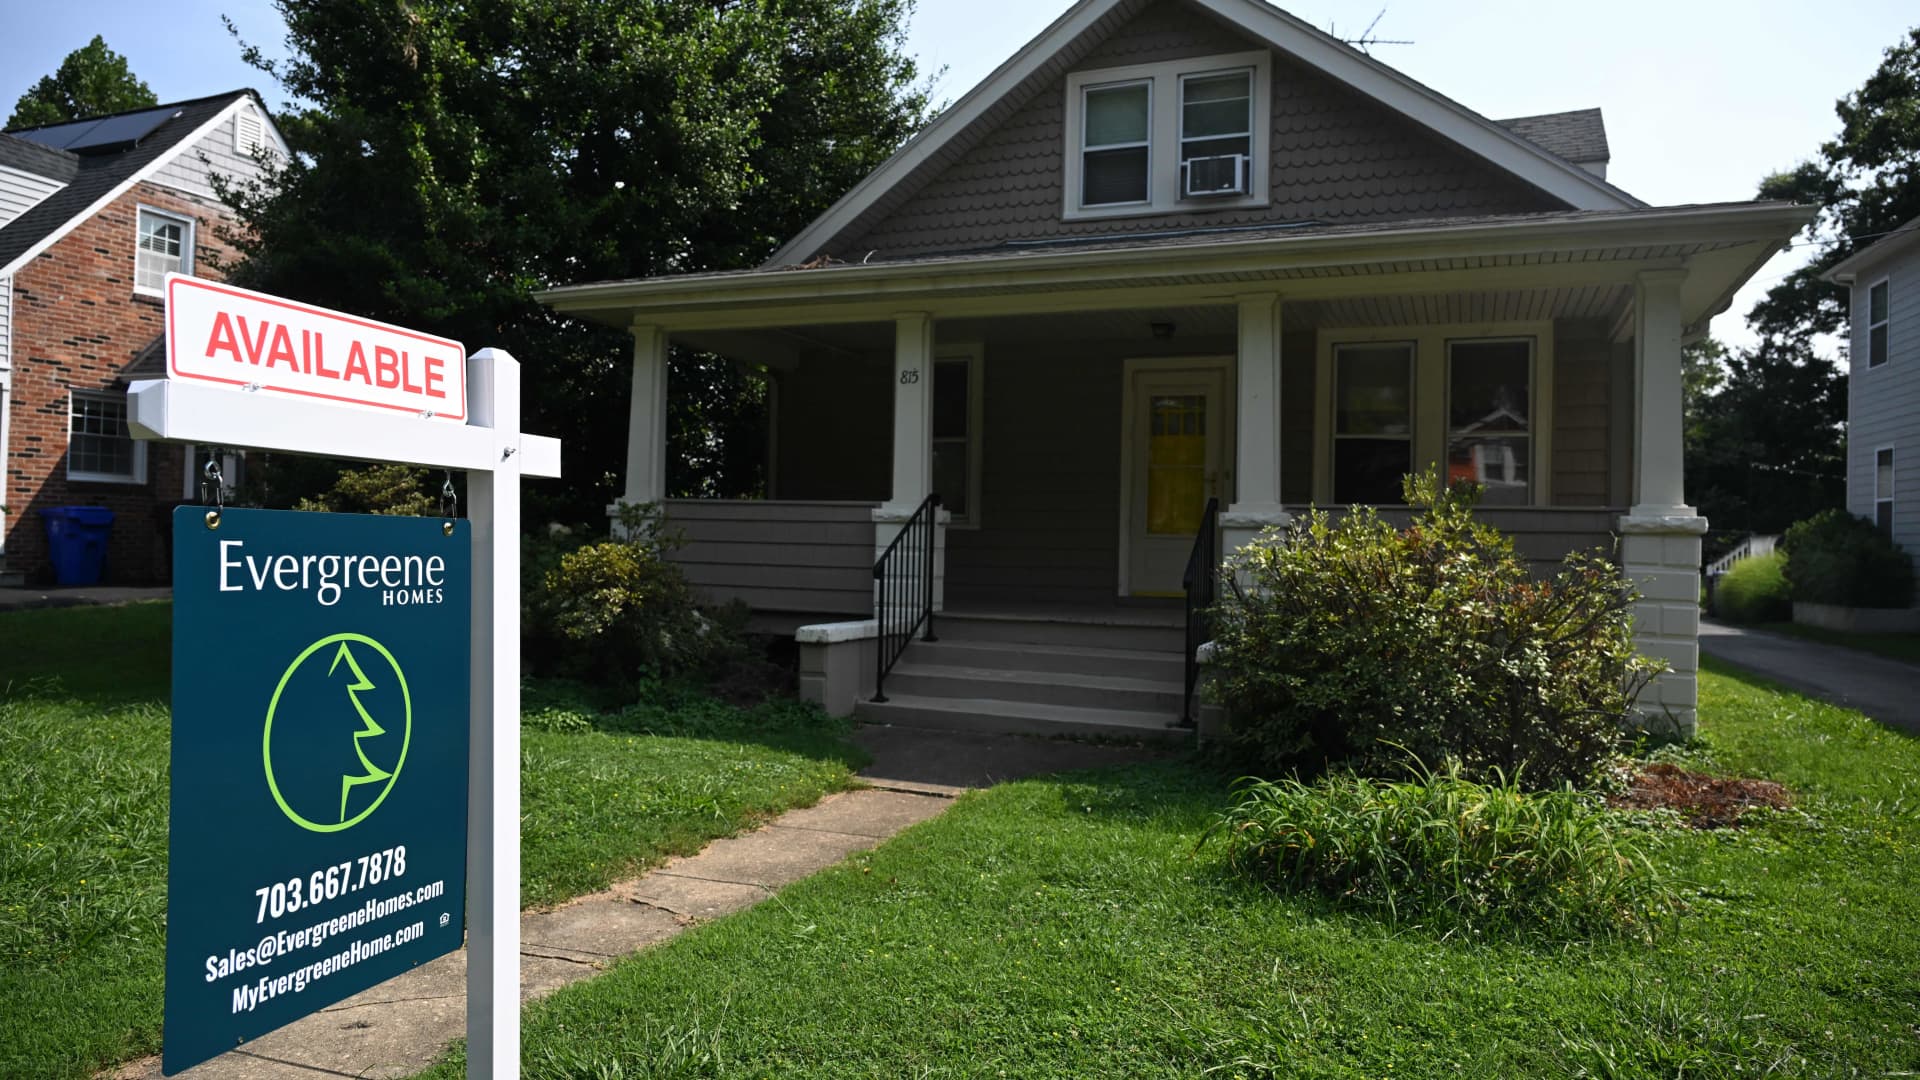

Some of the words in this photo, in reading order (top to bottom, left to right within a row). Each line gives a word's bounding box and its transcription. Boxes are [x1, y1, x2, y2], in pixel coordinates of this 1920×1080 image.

[205, 311, 446, 398] AVAILABLE
[900, 369, 919, 384] 815
[219, 540, 444, 605] Evergreene
[382, 588, 443, 605] HOMES
[255, 845, 406, 923] 703.667.7878
[205, 880, 444, 982] Sales@EvergreeneHomes.com
[232, 920, 424, 1014] MyEvergreeneHome.com
